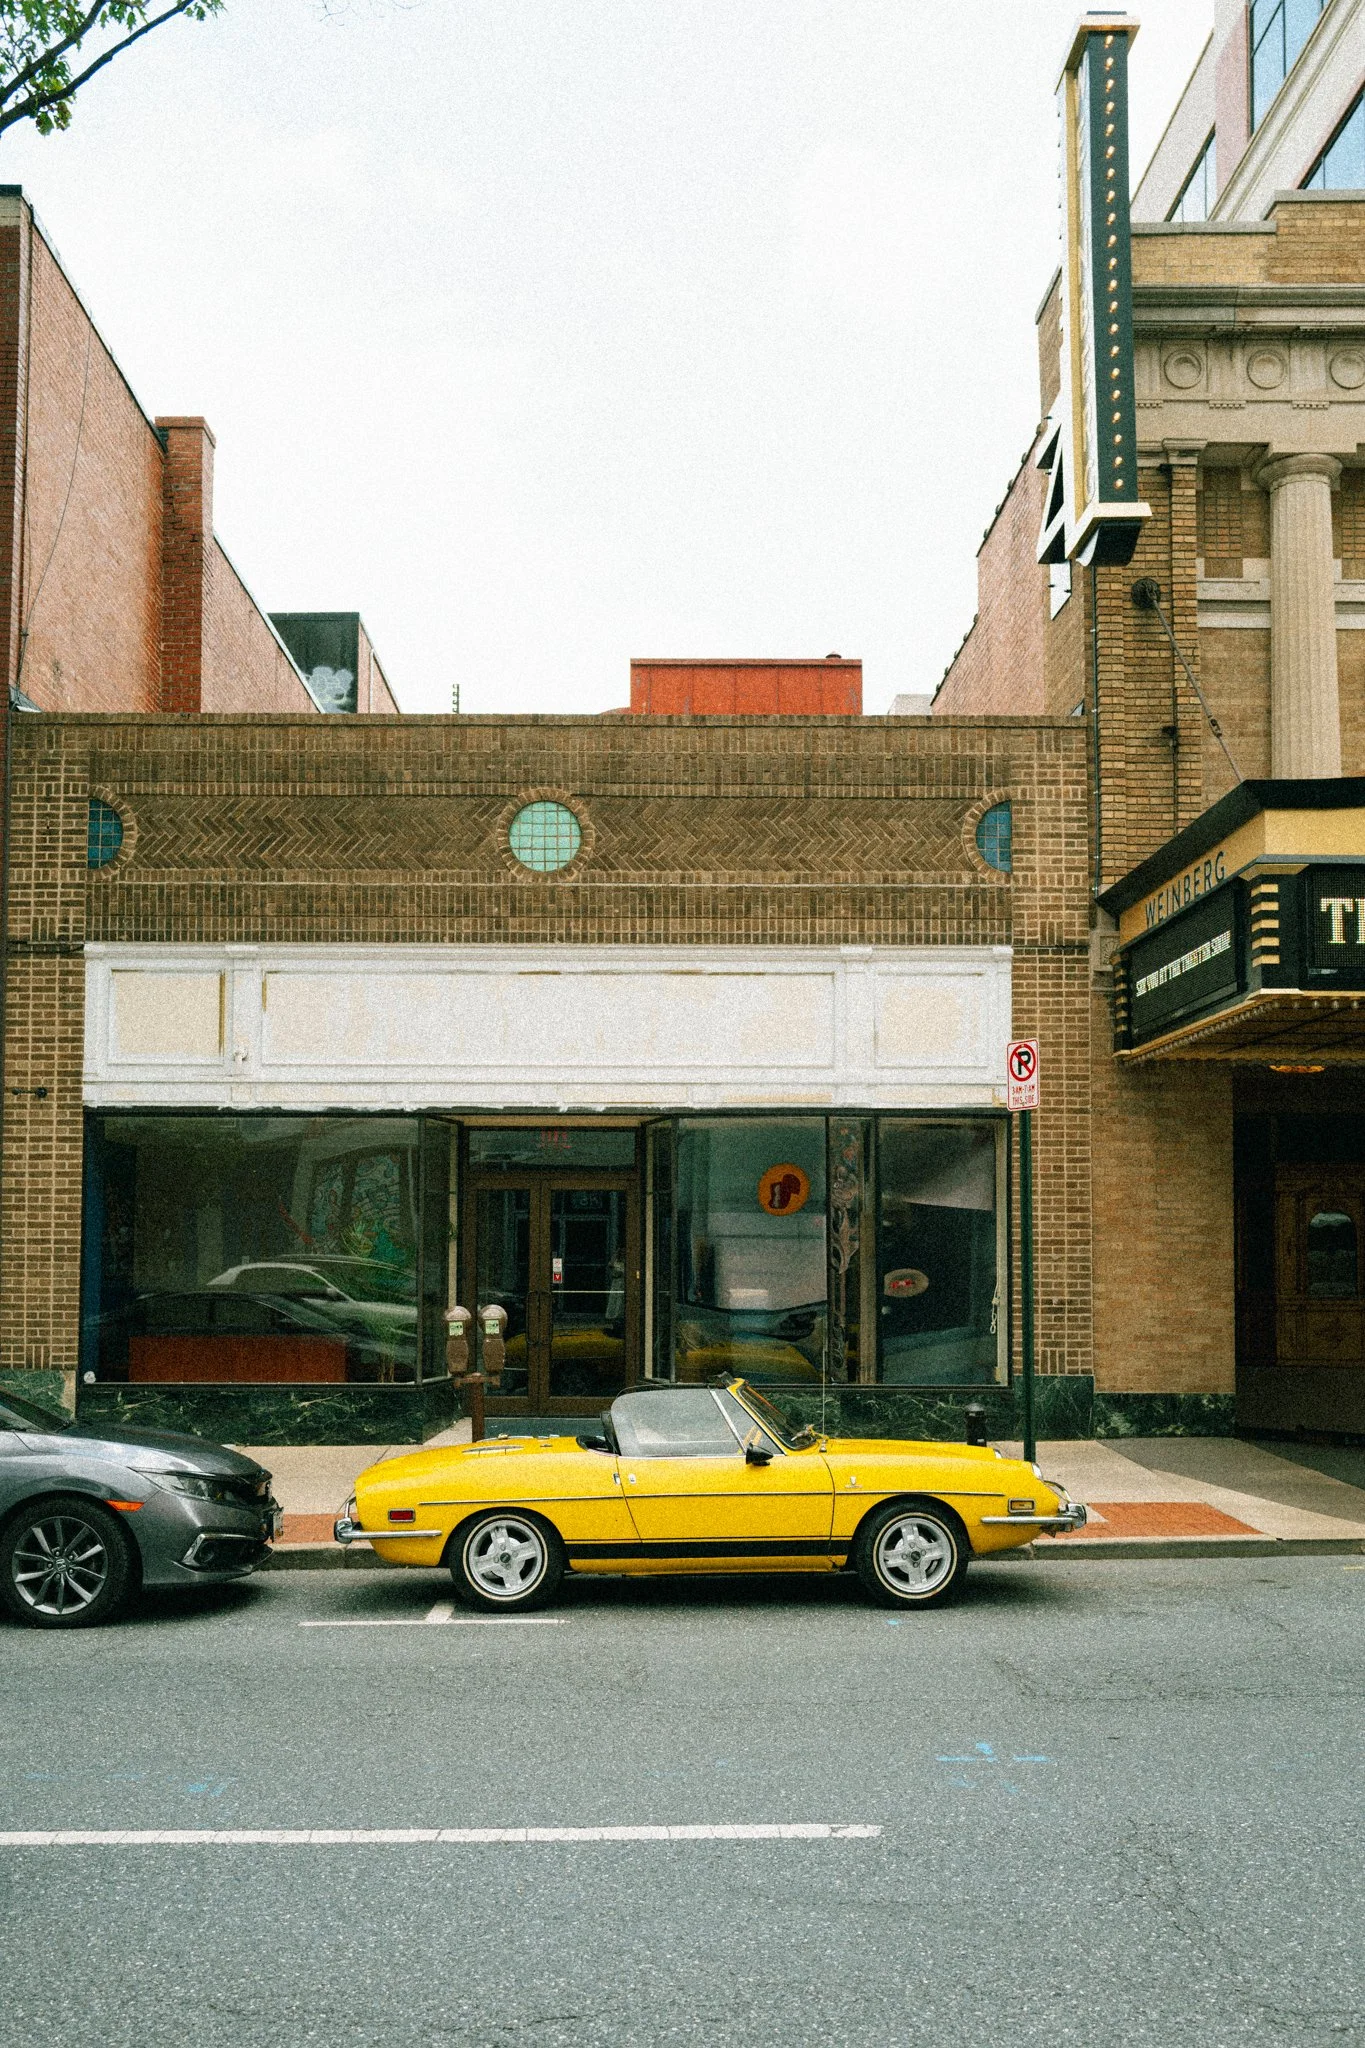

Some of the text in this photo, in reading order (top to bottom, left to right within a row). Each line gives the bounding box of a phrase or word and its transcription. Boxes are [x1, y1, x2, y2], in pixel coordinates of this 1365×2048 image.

[1145, 851, 1225, 929] WEINBERG
[1012, 1094, 1035, 1106] THIS SIDE
